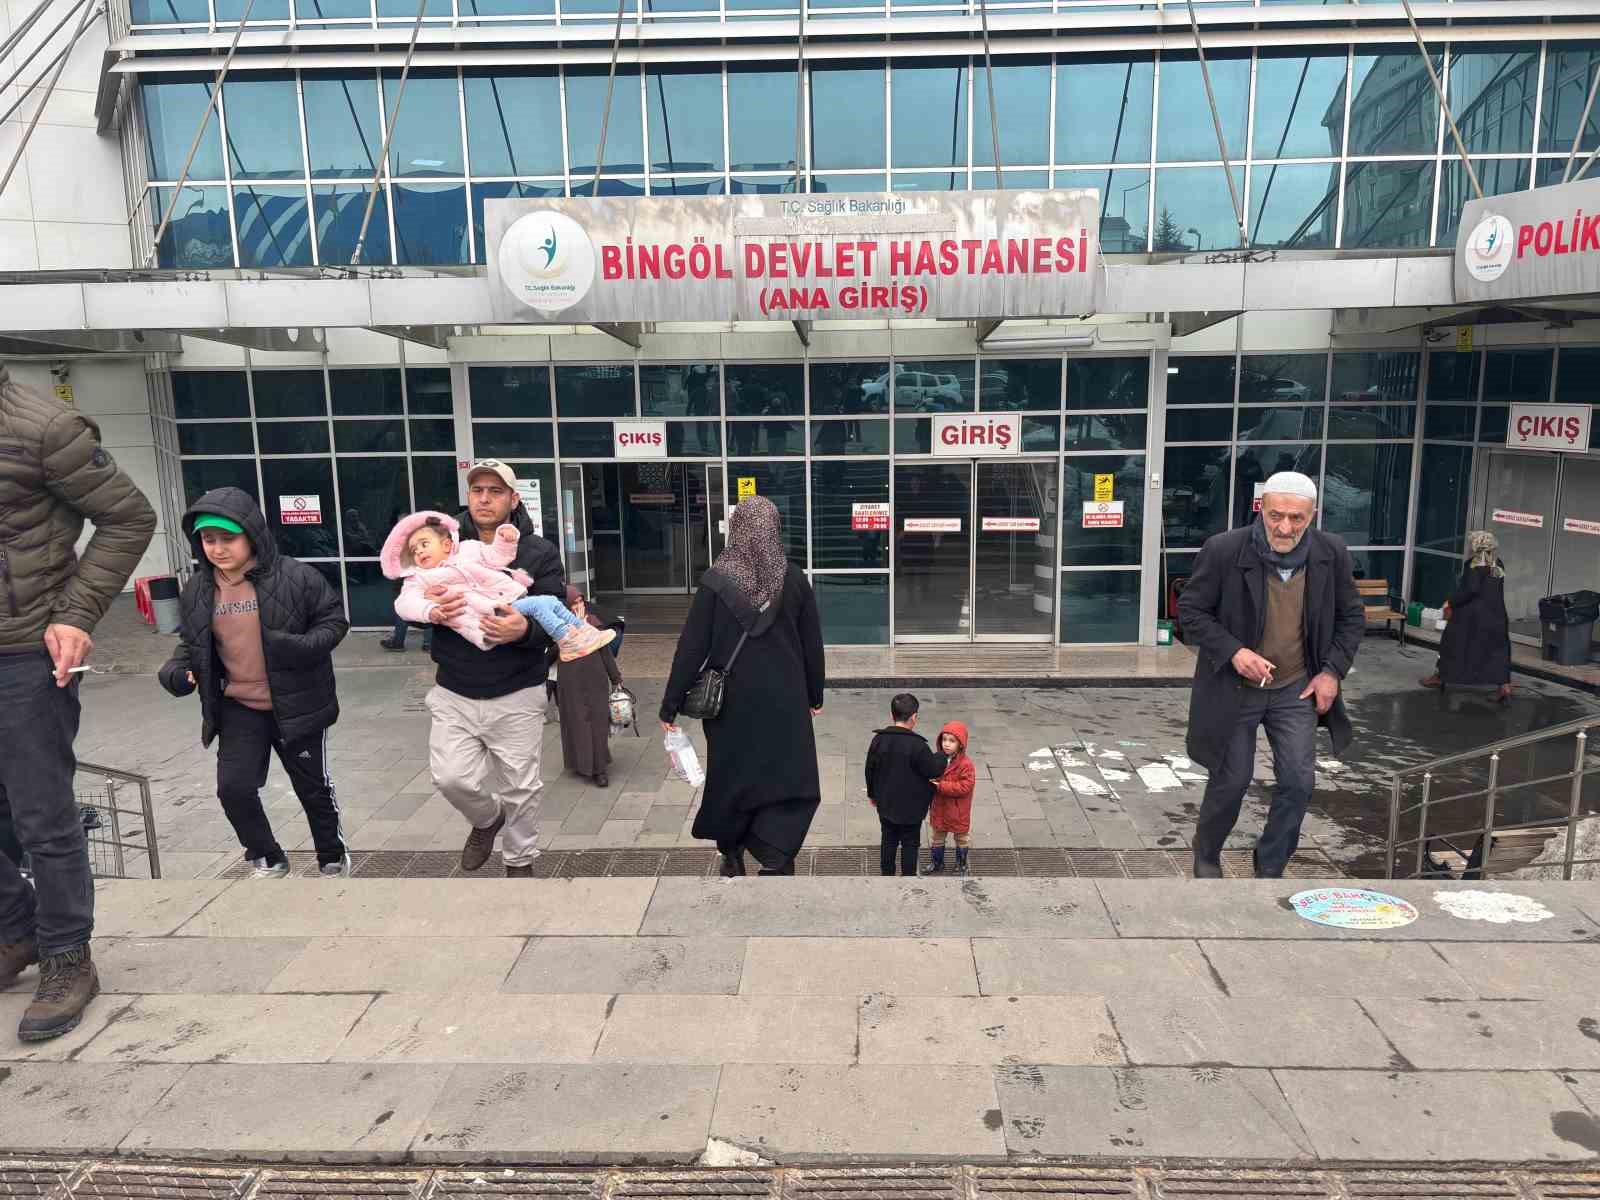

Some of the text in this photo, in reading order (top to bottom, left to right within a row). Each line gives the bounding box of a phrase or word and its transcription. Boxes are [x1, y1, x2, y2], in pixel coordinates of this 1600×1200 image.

[808, 200, 846, 215] Sağlık
[849, 198, 906, 214] Bakanlığı
[601, 229, 1089, 281] BİNGÖL DEVLET HASTANESİ
[759, 284, 929, 314] (ANA GİRİŞ)
[619, 433, 662, 446] ÇIKIŞ
[941, 420, 1012, 449] GİRİŞ
[1517, 416, 1580, 444] ÇIKIŞ
